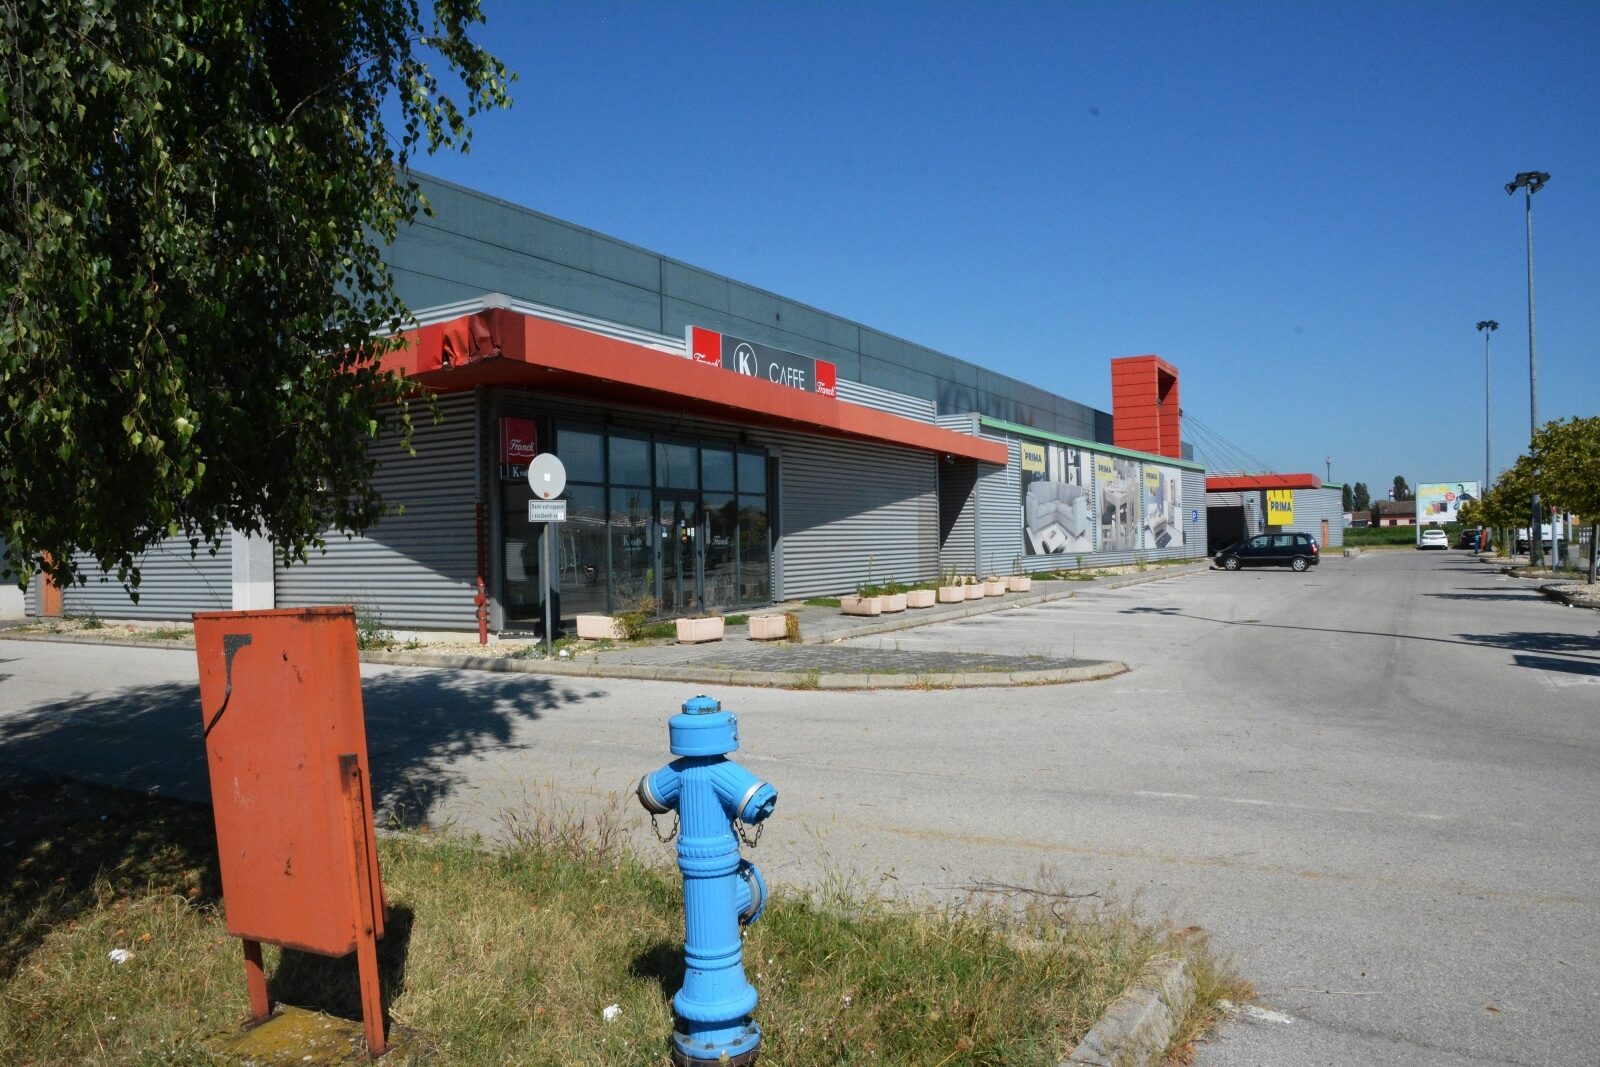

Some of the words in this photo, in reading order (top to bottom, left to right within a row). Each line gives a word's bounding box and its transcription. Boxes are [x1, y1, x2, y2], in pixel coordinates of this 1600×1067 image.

[769, 363, 805, 391] CAFFE
[510, 439, 535, 452] Franck
[1024, 451, 1043, 464] PRIMA
[1098, 464, 1112, 473] PRIMA
[1270, 501, 1292, 512] PRIMA
